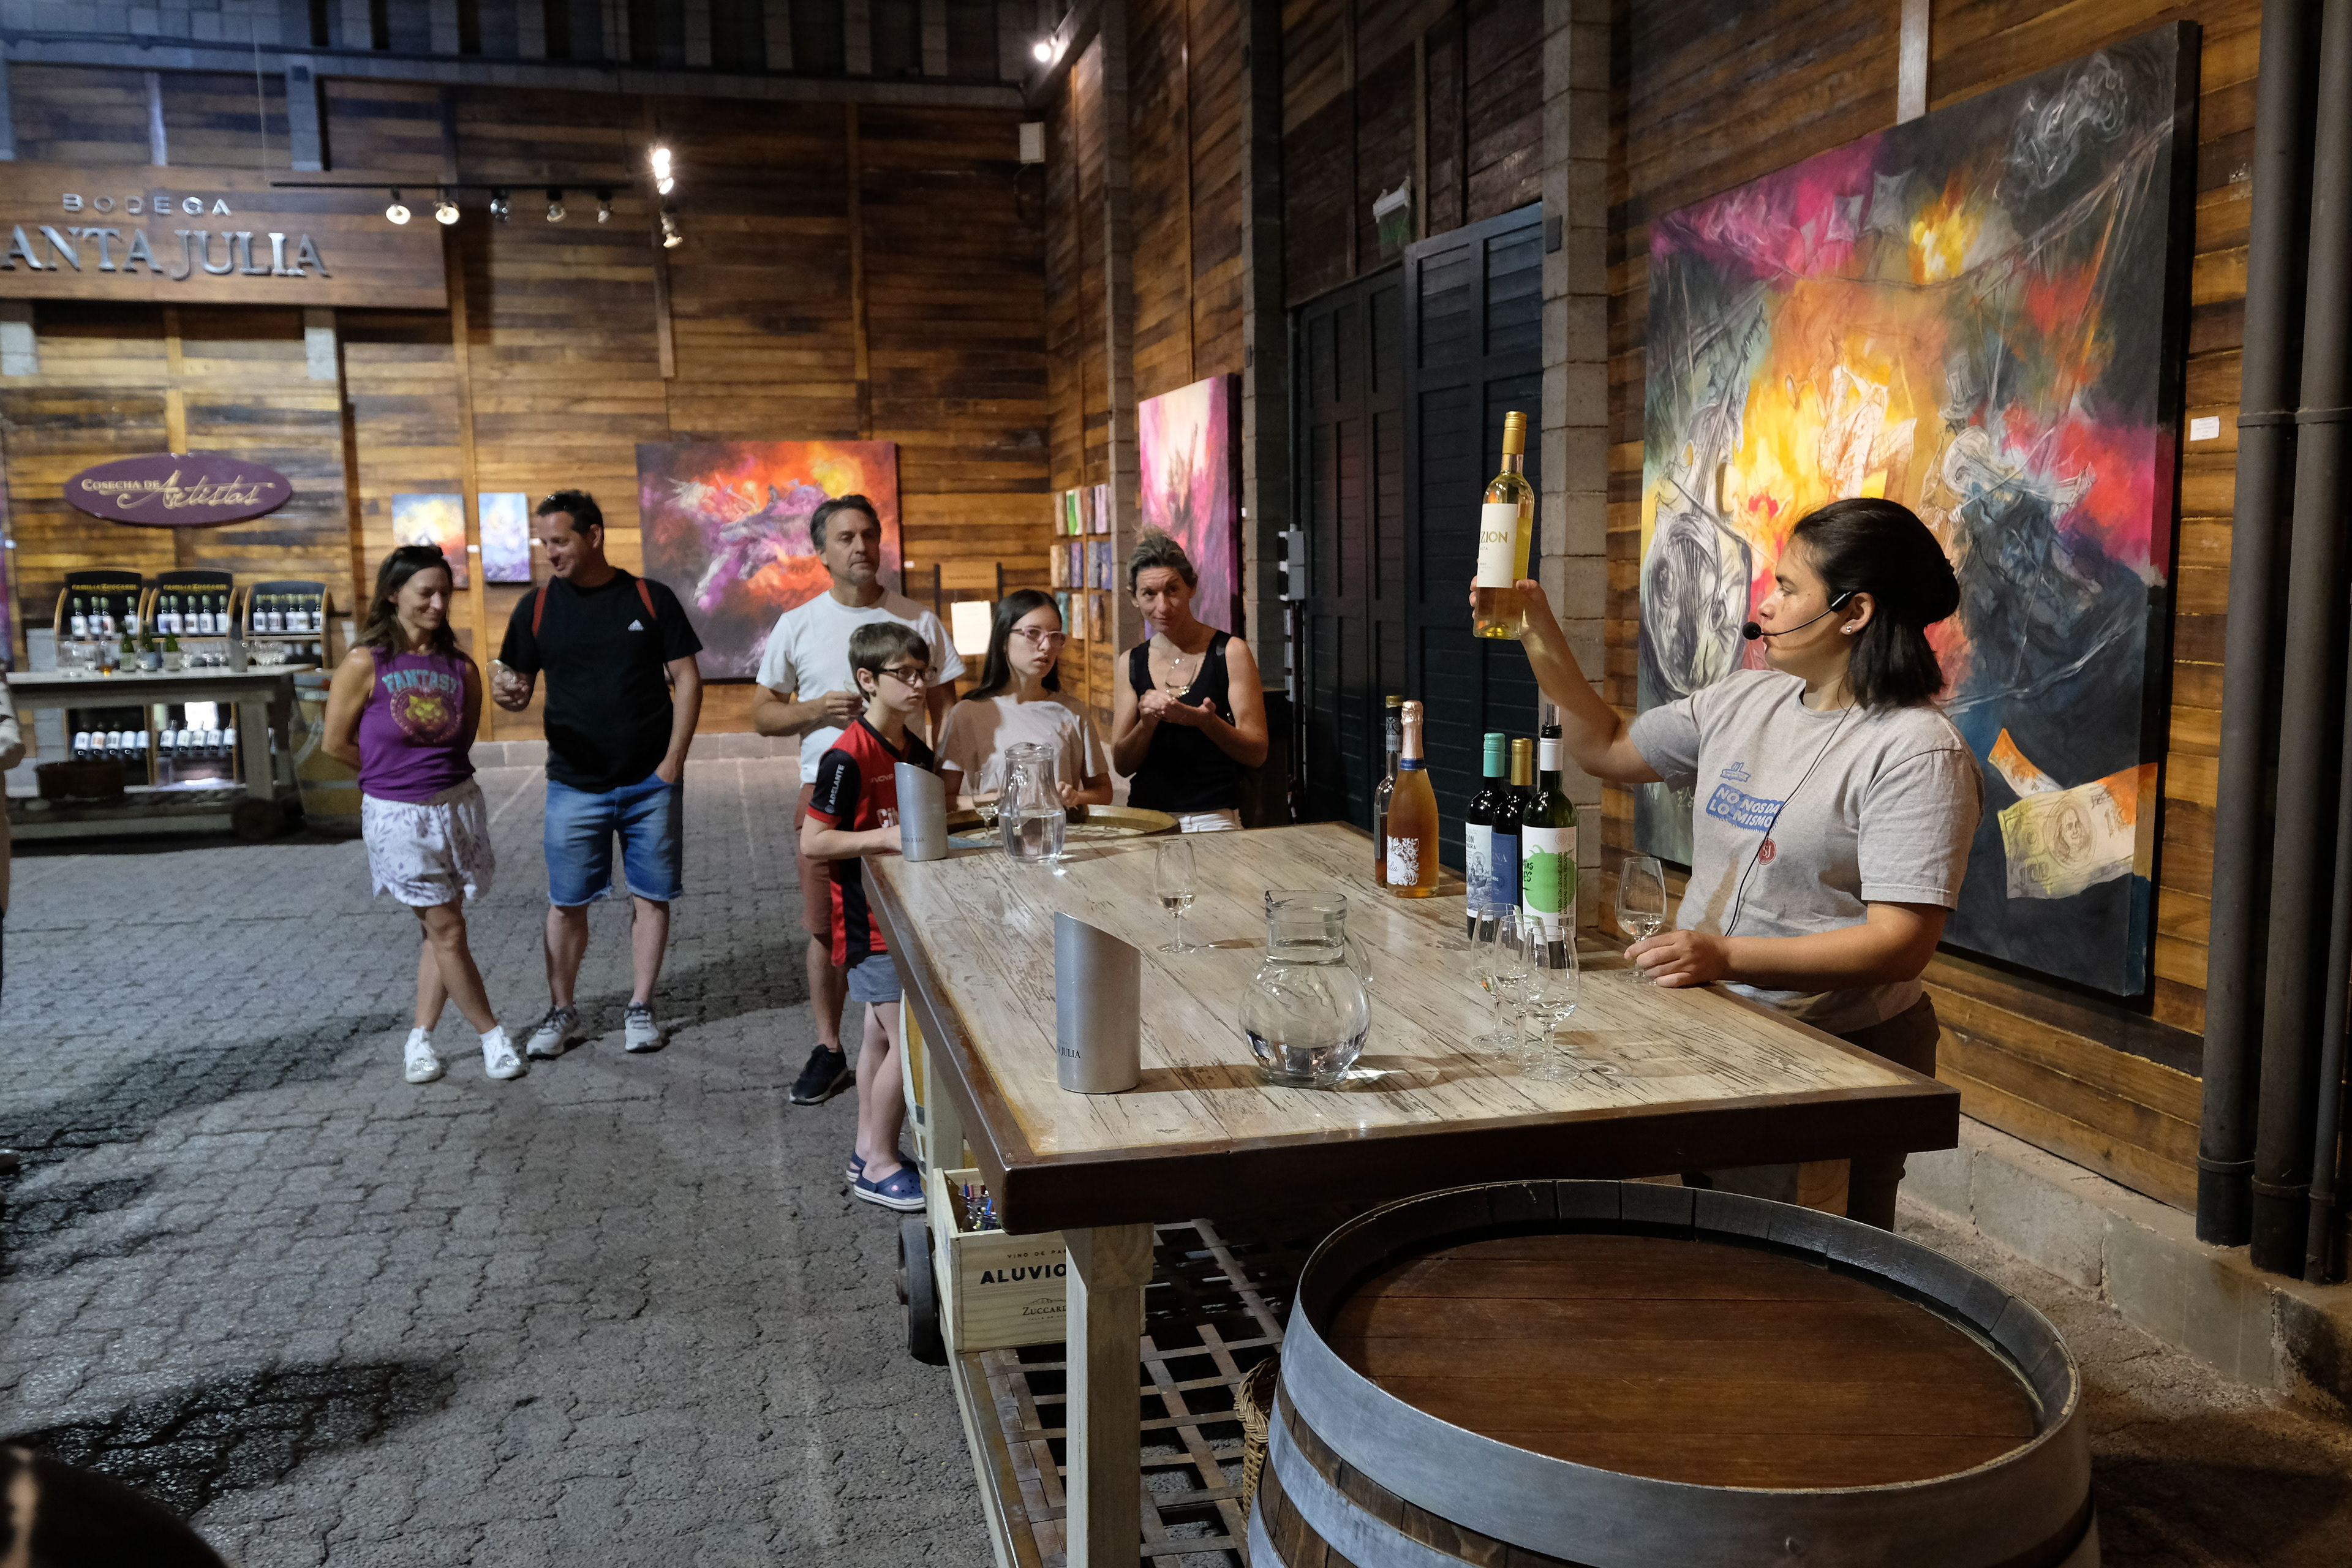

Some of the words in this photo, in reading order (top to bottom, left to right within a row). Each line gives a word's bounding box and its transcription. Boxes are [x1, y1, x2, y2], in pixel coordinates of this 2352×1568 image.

[62, 192, 232, 216] BODEGA
[169, 229, 333, 281] JULIA
[116, 470, 275, 509] Artistas
[143, 480, 160, 489] DE
[382, 669, 458, 694] FANTASY
[829, 764, 845, 805] ADELANTE
[1716, 786, 1740, 804] NO
[1709, 799, 1730, 815] LO
[1732, 810, 1774, 827] MISMO
[1762, 845, 1772, 859] SJ
[981, 1263, 1066, 1284] ALUVIO
